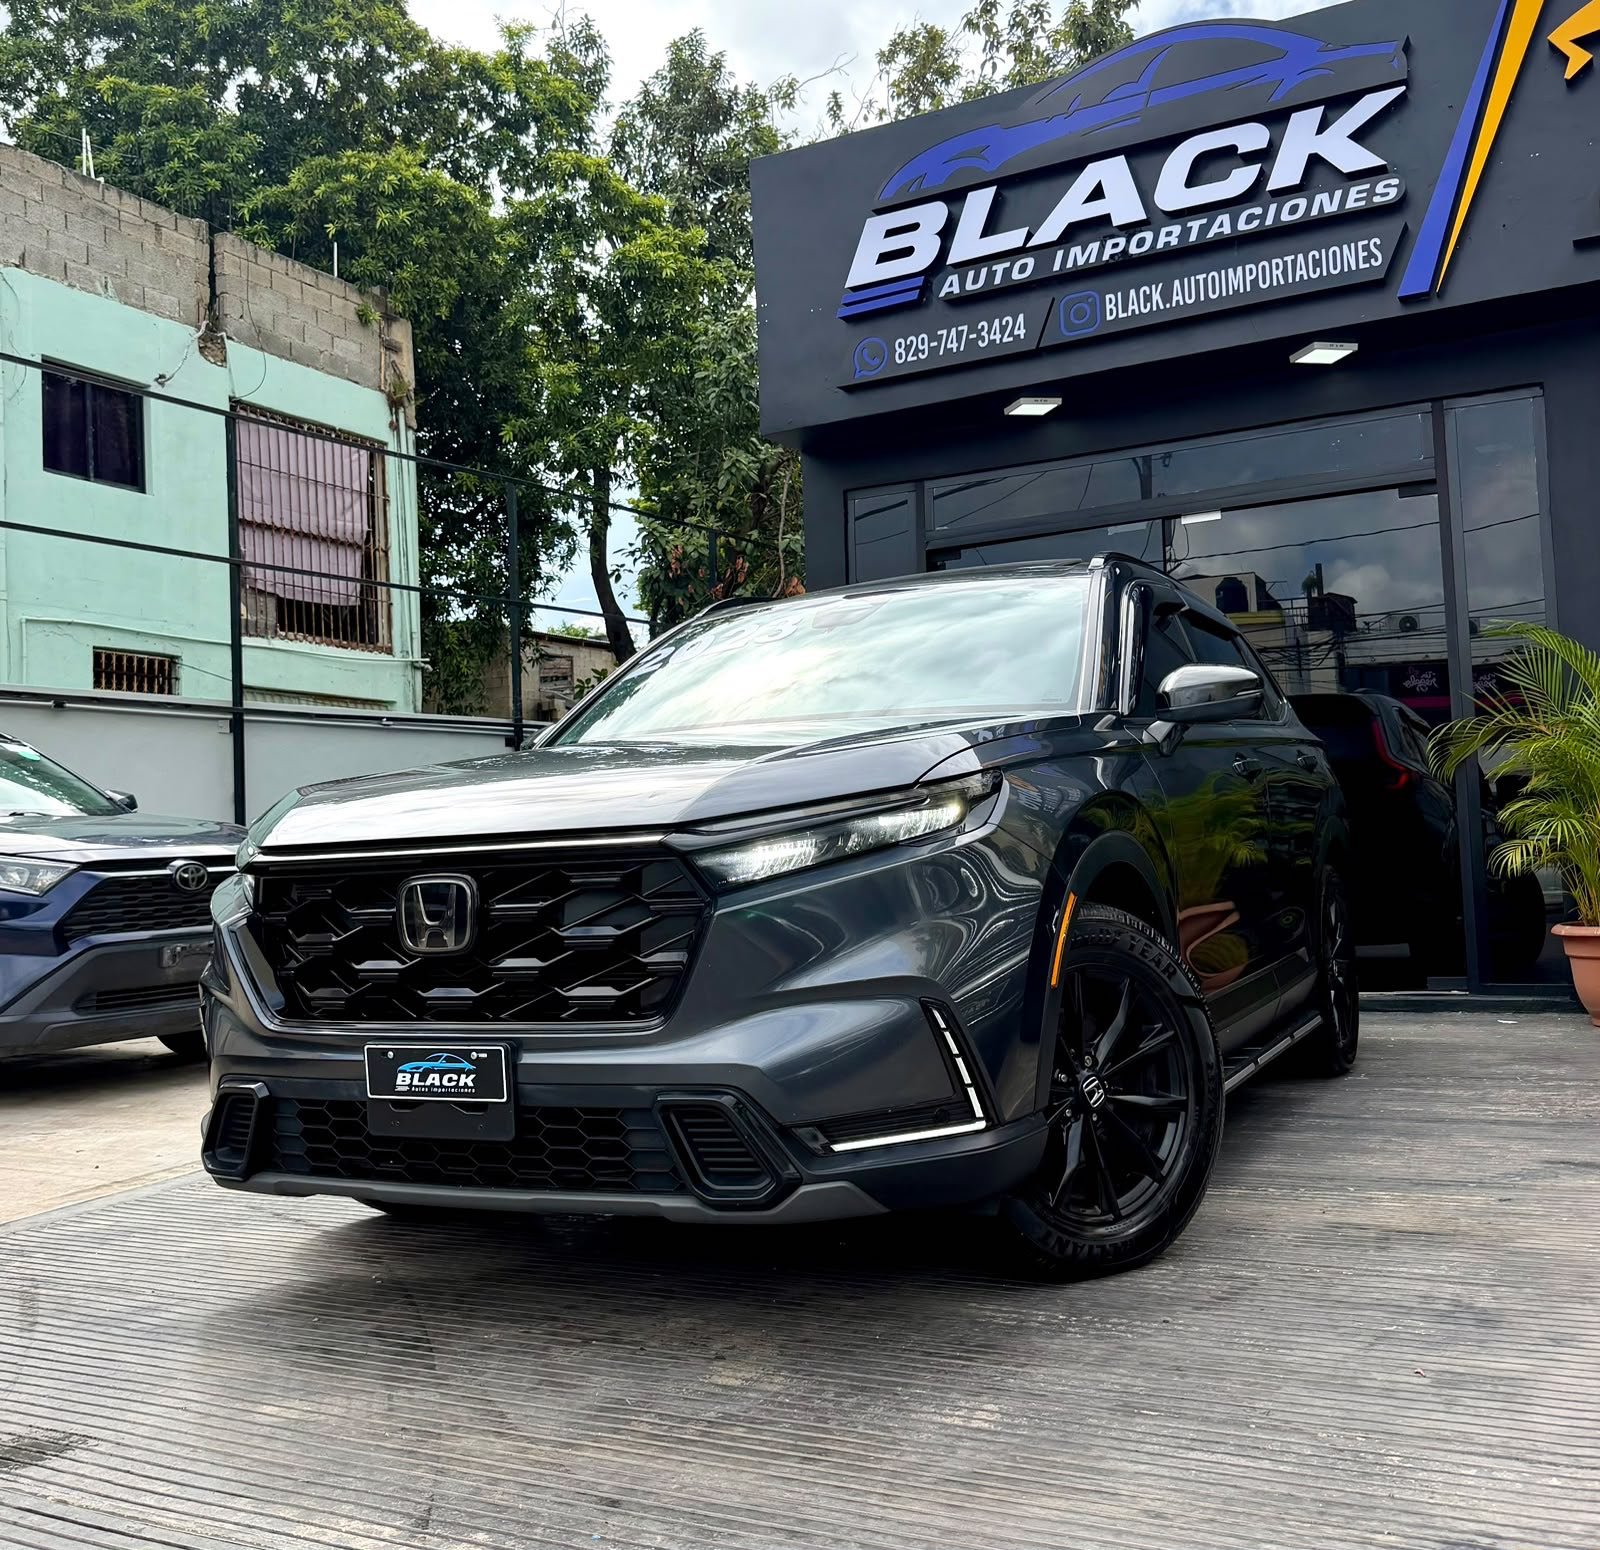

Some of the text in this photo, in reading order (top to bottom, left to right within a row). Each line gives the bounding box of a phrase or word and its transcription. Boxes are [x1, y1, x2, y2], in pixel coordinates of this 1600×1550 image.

[845, 86, 1407, 288] BLACK
[938, 178, 1399, 298] AUTO IMPORTACIONES
[1105, 237, 1383, 321] BLACK.AUTOIMPORTACIONES
[894, 313, 1026, 364] 829-747-3424
[1127, 933, 1178, 980] YEAR
[395, 1072, 477, 1087] BLACK
